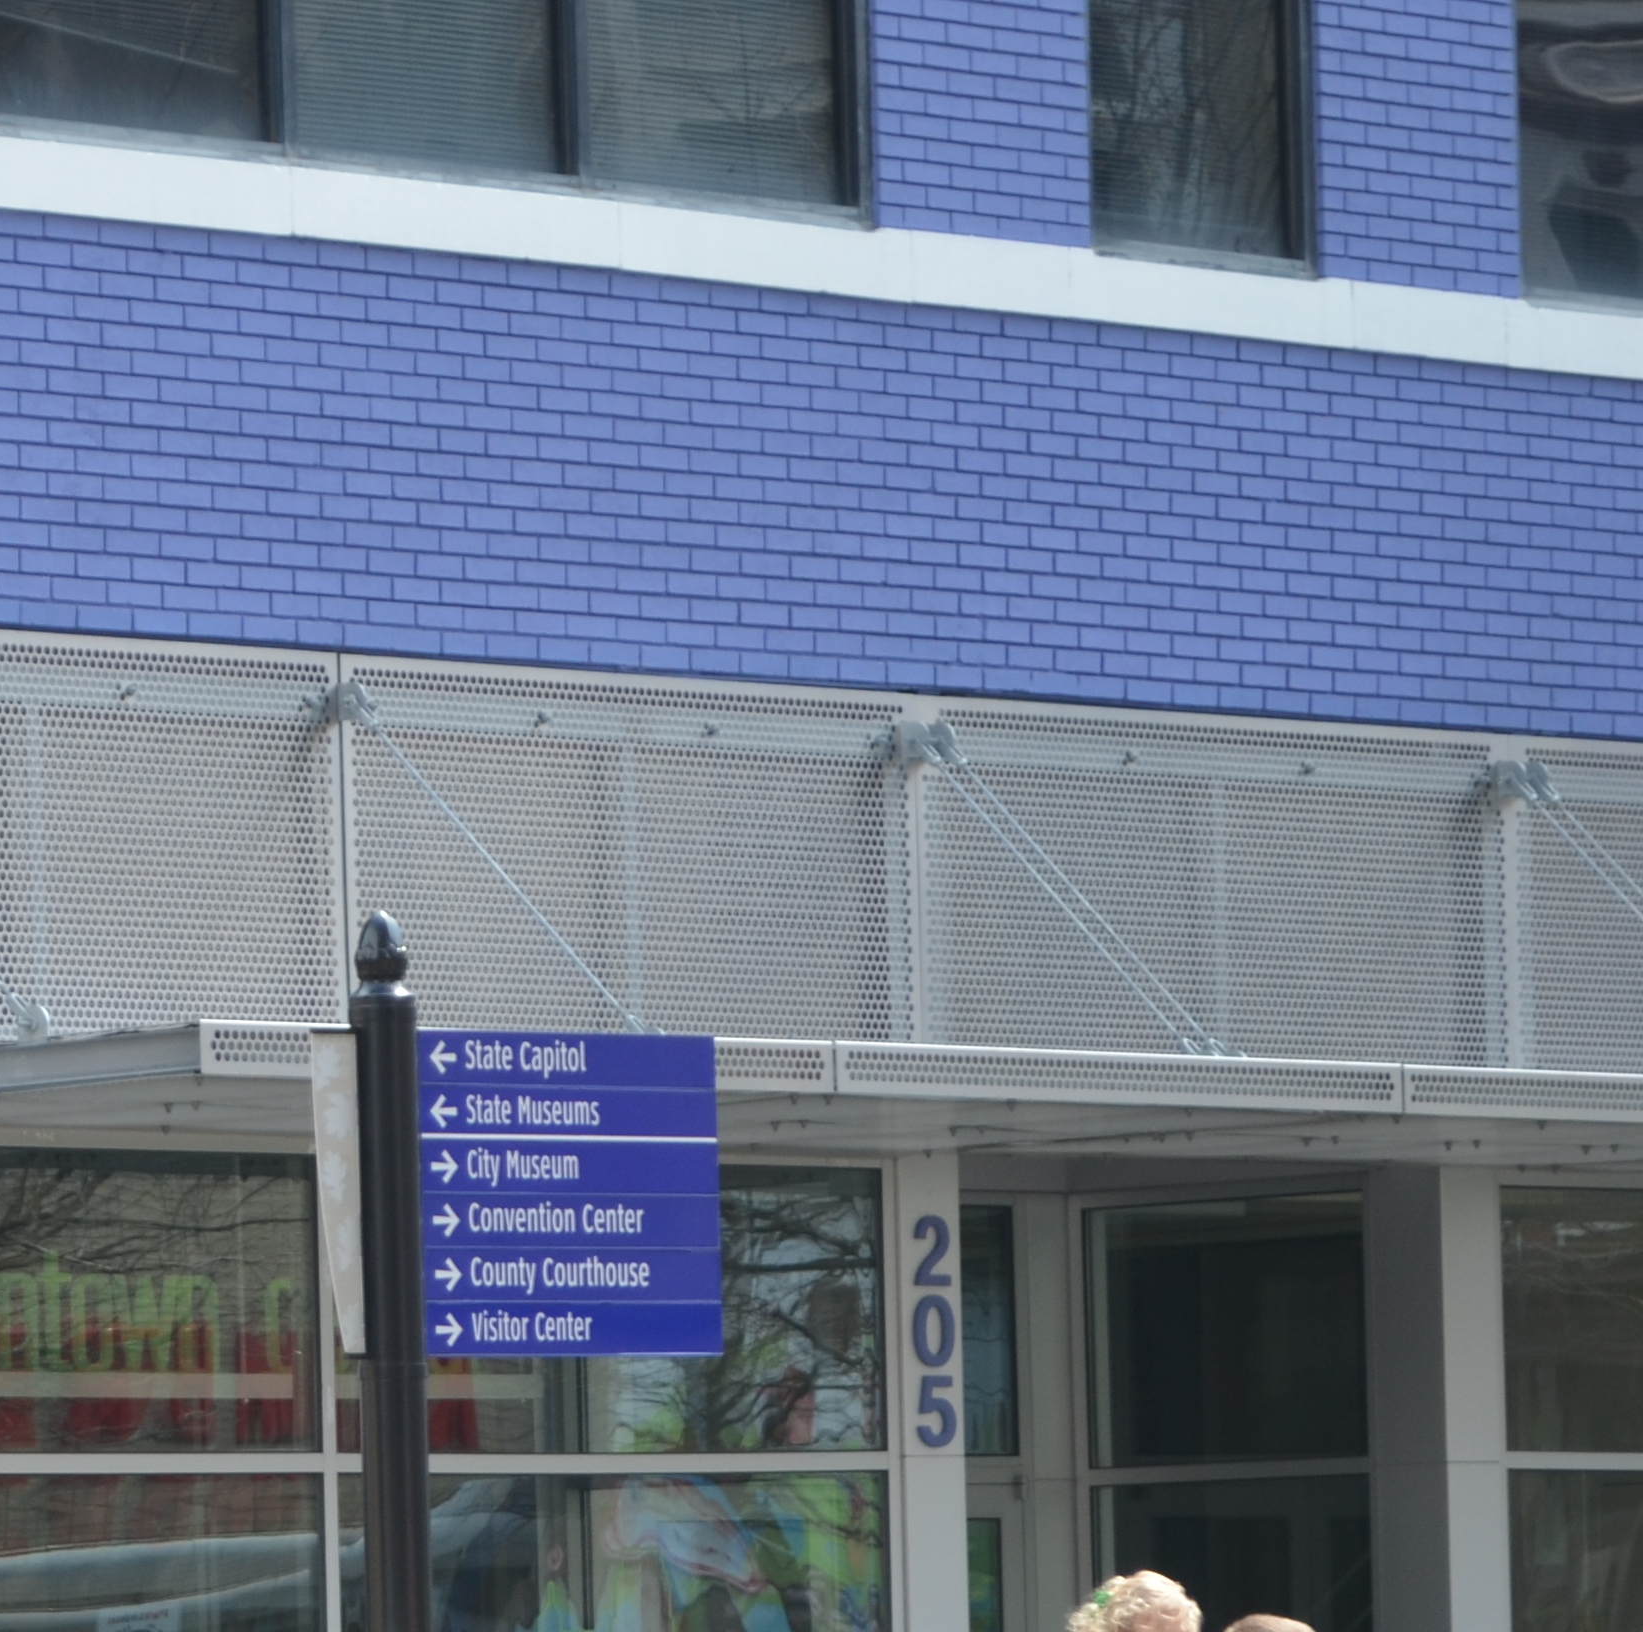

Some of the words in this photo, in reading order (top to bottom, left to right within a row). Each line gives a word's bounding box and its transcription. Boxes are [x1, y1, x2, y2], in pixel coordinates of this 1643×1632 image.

[465, 1039, 514, 1071] State
[519, 1041, 586, 1079] Capitol
[466, 1094, 512, 1125] State
[518, 1095, 600, 1126] Museums
[467, 1147, 500, 1187] City
[506, 1150, 580, 1179] Museum
[468, 1201, 576, 1232] Convention
[582, 1203, 644, 1234] Center
[470, 1257, 536, 1295] County
[542, 1256, 651, 1287] Courthouse
[471, 1310, 529, 1341] Visitor
[535, 1312, 593, 1341] Center
[912, 1214, 957, 1448] 205
